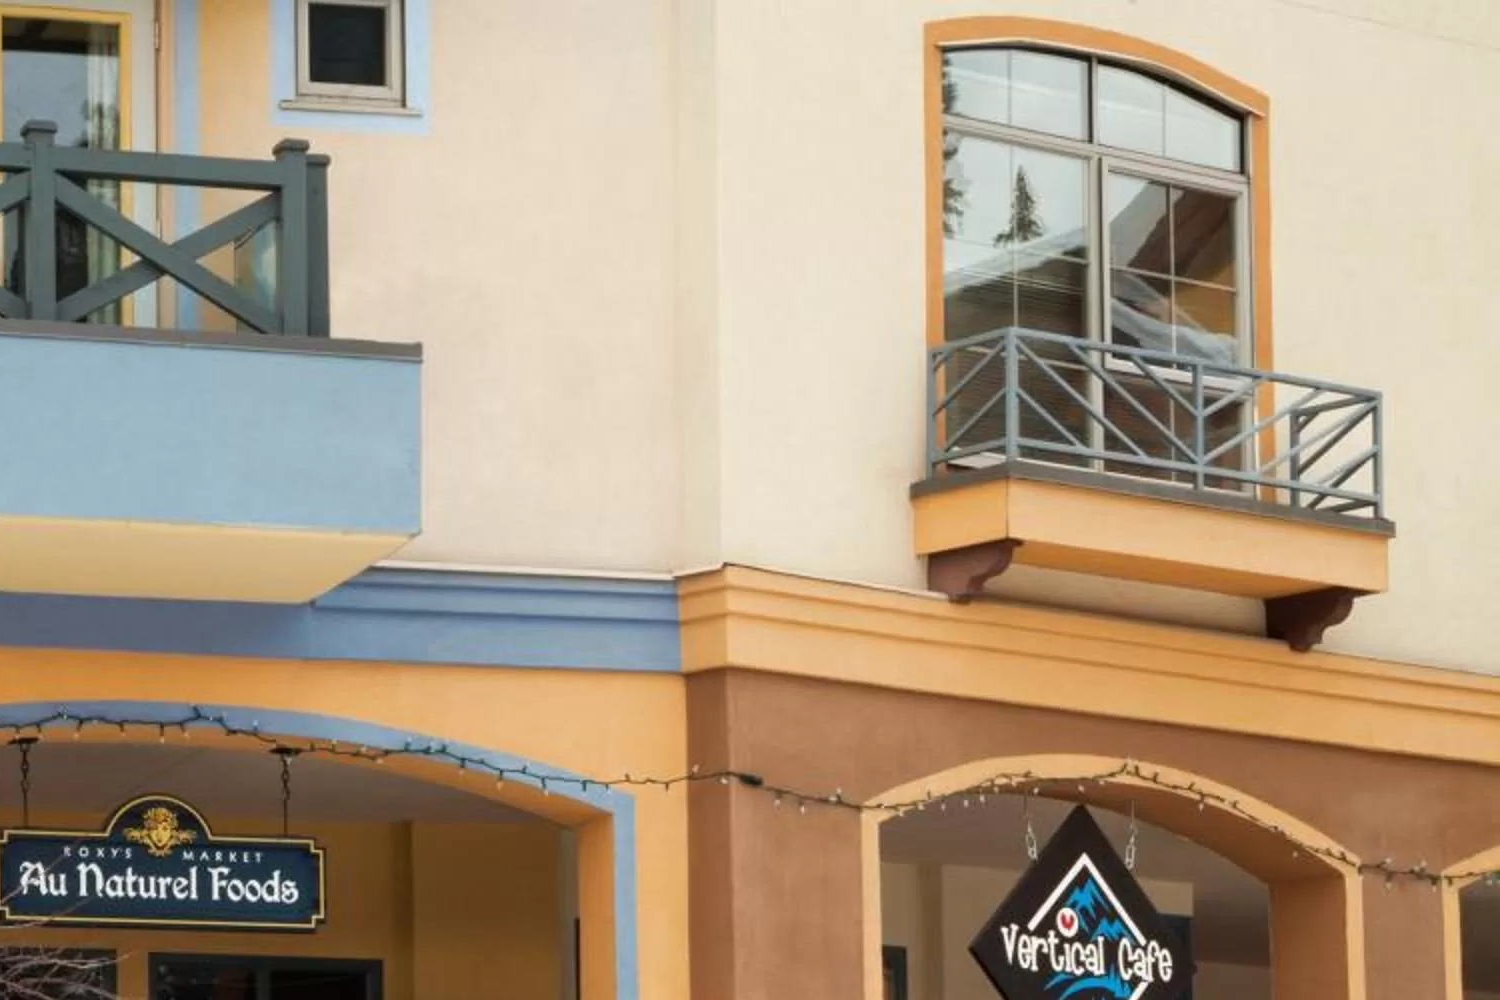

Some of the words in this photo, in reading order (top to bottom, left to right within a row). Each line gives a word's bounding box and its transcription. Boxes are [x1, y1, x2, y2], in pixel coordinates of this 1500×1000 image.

[182, 851, 263, 864] MARKET
[19, 861, 67, 897] Au
[76, 863, 199, 900] Naturel
[208, 866, 300, 905] Foods
[1000, 923, 1106, 976] Vertical
[1118, 937, 1173, 983] Cafe
